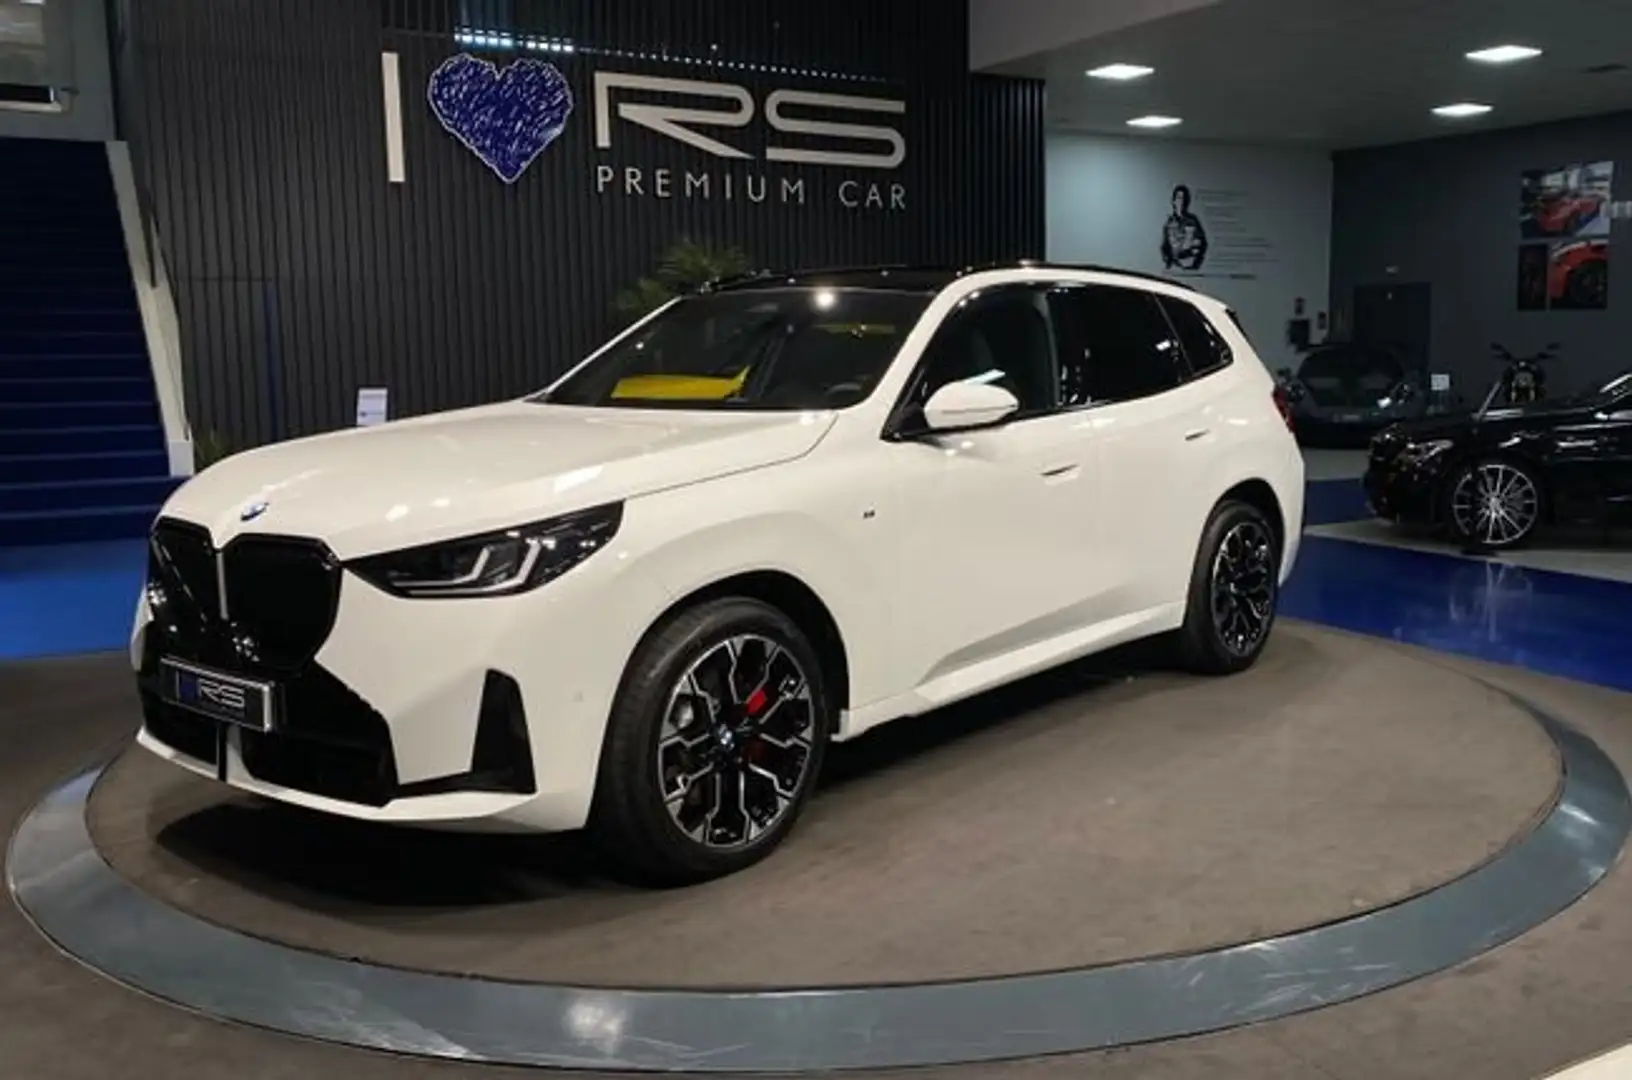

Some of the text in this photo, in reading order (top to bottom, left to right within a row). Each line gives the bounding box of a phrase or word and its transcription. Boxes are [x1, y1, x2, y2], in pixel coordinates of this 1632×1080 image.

[381, 51, 906, 183] I RS
[597, 165, 906, 210] PREMIUM CAR
[197, 678, 245, 708] RS
